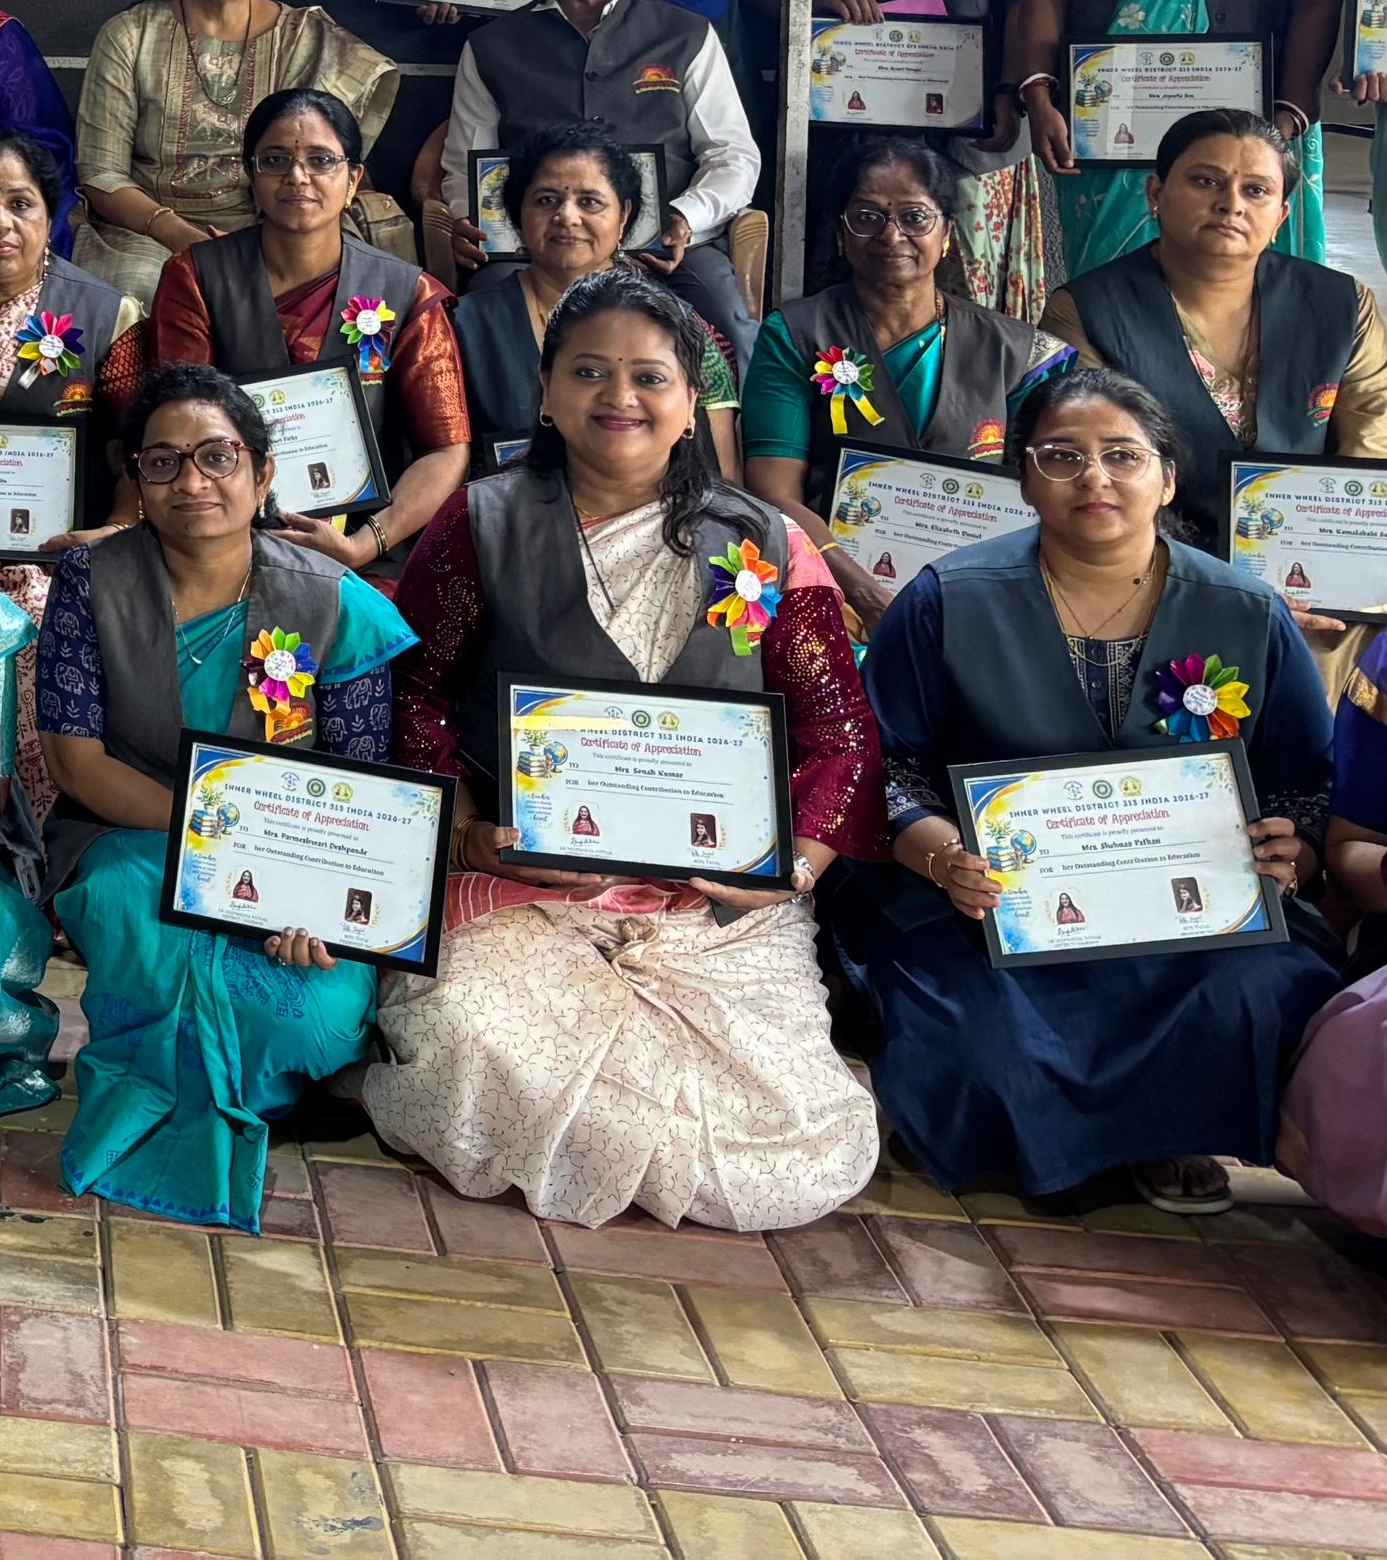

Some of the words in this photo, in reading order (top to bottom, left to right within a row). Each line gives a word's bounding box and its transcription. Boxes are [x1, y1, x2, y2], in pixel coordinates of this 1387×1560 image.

[224, 784, 251, 793] INNER
[255, 789, 282, 800] WHEEL
[285, 796, 326, 808] DISTRICT
[347, 807, 372, 817] INDIA
[1009, 809, 1038, 818] INNER
[1042, 806, 1072, 814] WHEEL
[1075, 801, 1119, 812] DISTRICT
[1141, 797, 1169, 805] INDIA
[254, 801, 299, 817] Certificate
[302, 811, 312, 821] of
[314, 813, 369, 831] Appreciation
[1046, 816, 1095, 829] Certificate
[1098, 815, 1107, 825] of
[1112, 809, 1170, 825] Appreciation
